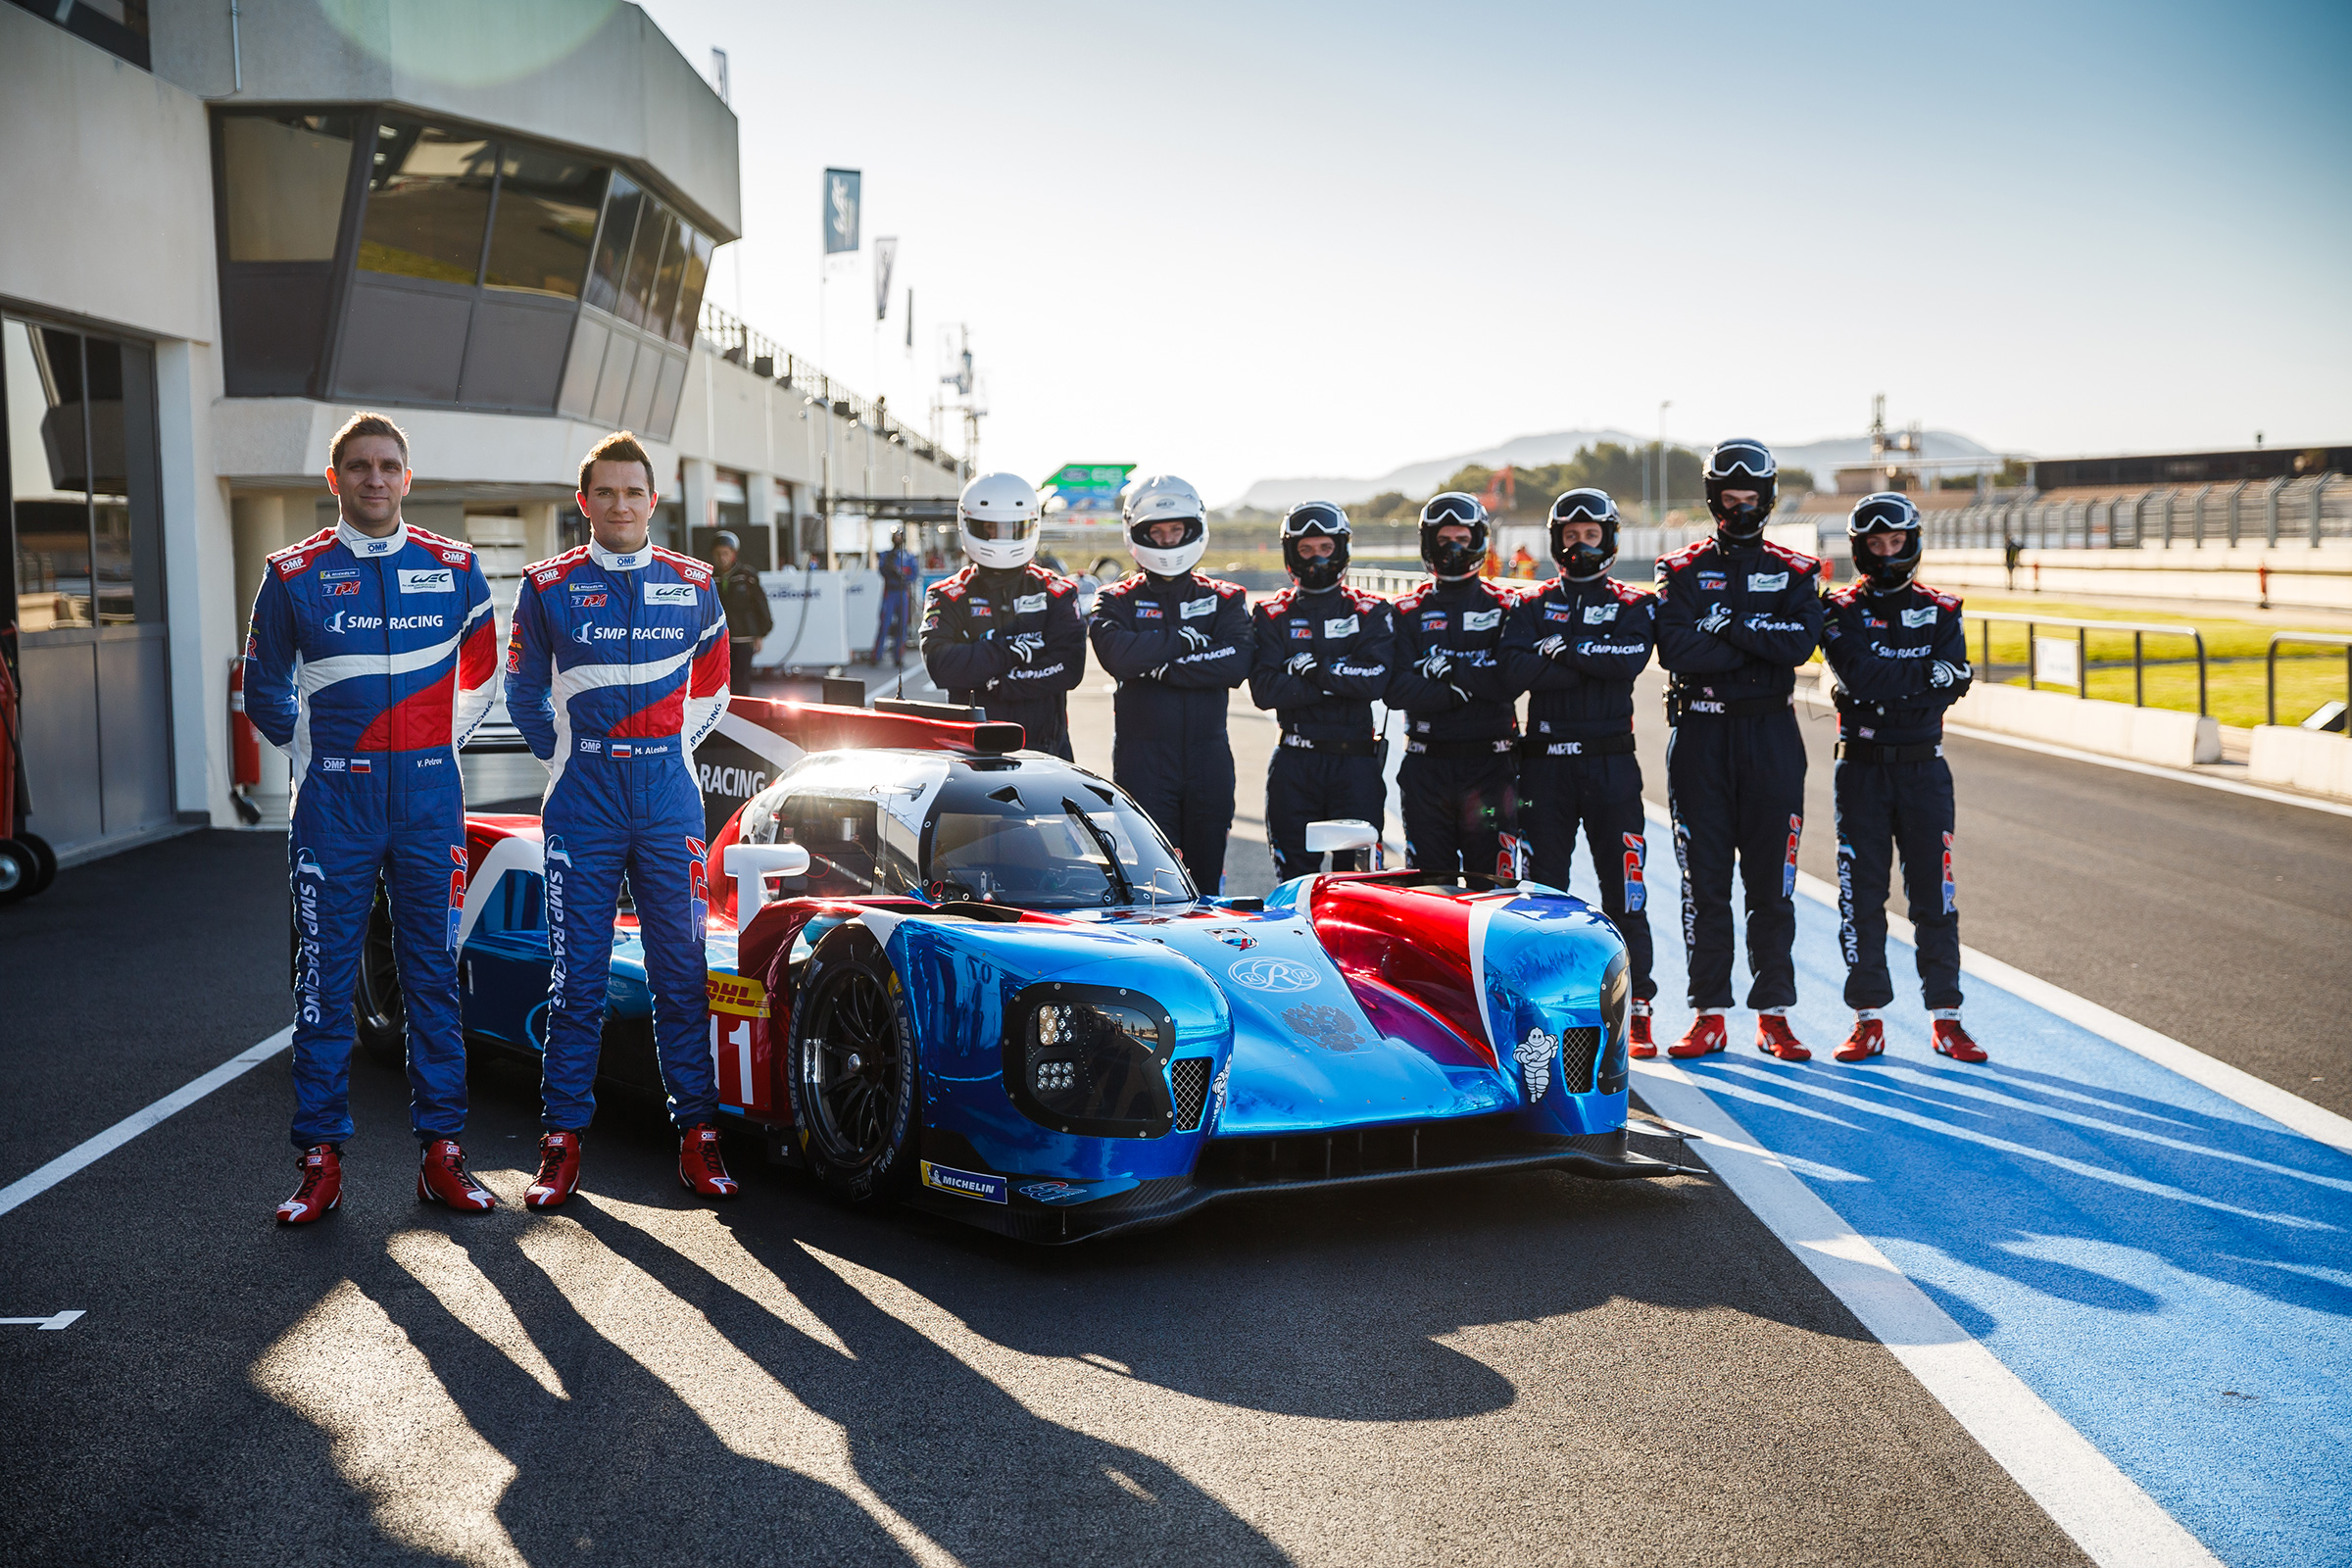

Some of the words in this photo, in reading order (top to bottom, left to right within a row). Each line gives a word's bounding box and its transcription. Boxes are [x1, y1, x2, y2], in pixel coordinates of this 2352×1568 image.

[368, 543, 388, 553] OMP
[281, 558, 304, 571] OMP
[442, 552, 466, 564] OMP
[617, 557, 636, 565] OMP
[410, 572, 450, 584] WEC
[537, 570, 559, 582] OMP
[684, 569, 707, 581] OMP
[655, 587, 692, 597] WEC
[347, 615, 383, 629] SMP
[389, 614, 443, 629] RACING
[594, 627, 627, 640] SMP
[632, 627, 684, 640] RACING
[1591, 643, 1611, 654] SMP
[1611, 643, 1644, 655] RACING
[1690, 700, 1726, 714] MRTC
[466, 700, 493, 737] RACING
[695, 703, 722, 742] RACING
[580, 742, 602, 752] OMP
[645, 745, 668, 755] Aleshin
[1546, 741, 1583, 756] MRTC
[323, 760, 346, 770] OMP
[424, 758, 443, 767] Petrov
[700, 763, 766, 799] RACING
[1838, 859, 1853, 901] SMP
[549, 869, 564, 923] SMP
[299, 882, 318, 936] SMP
[1682, 880, 1698, 946] RACING
[1840, 901, 1860, 964] RACING
[551, 924, 567, 1009] RACING
[303, 937, 320, 1025] RACING
[707, 979, 756, 1006] DHL
[788, 993, 803, 1110] MICHELIN
[892, 1016, 912, 1132] MICHELIN
[942, 1175, 995, 1194] MICHELIN
